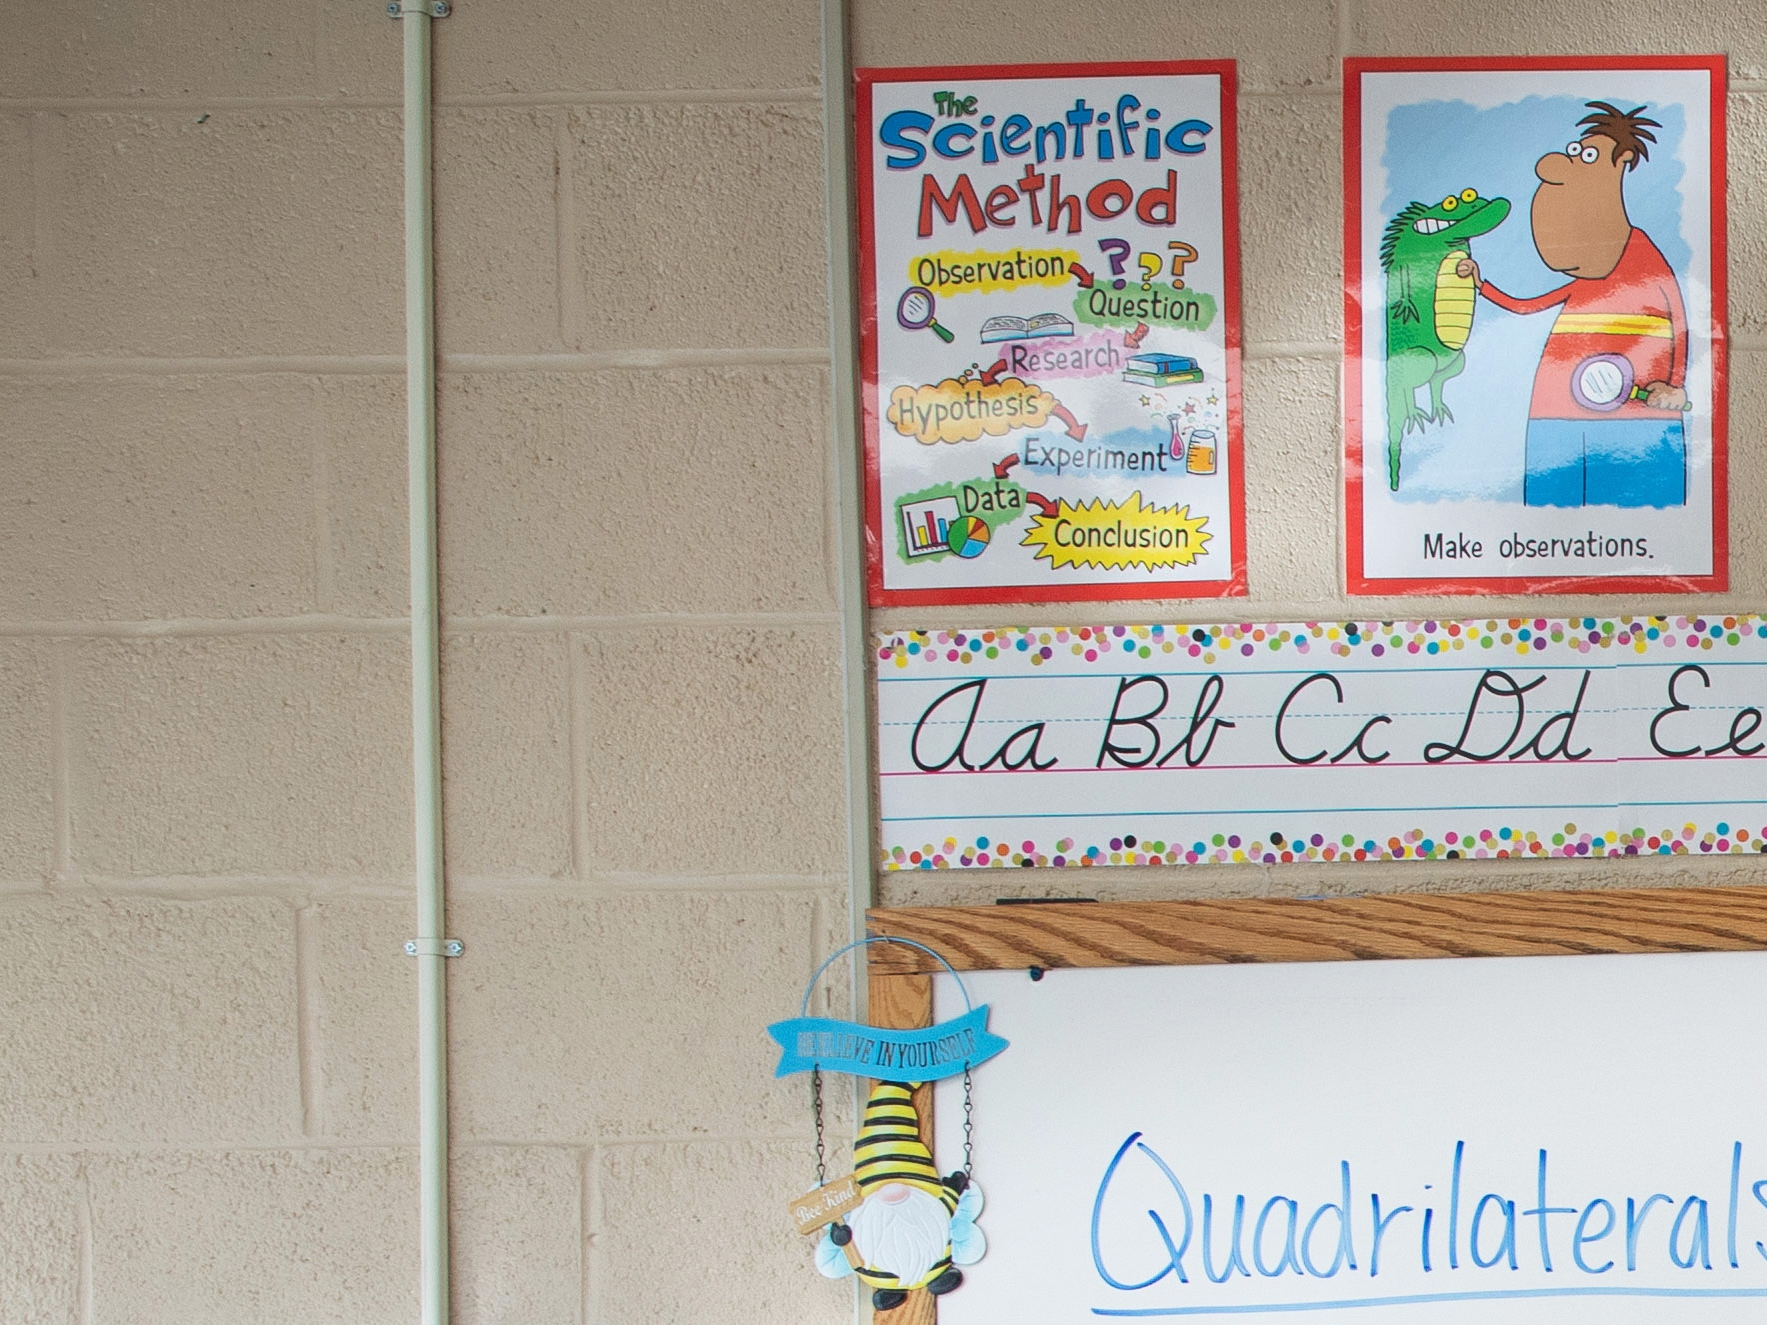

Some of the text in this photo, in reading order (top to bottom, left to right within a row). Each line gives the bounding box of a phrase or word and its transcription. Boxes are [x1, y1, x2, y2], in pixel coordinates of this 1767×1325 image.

[931, 91, 978, 120] The
[880, 94, 1212, 170] Scientific
[917, 162, 1179, 241] Method
[916, 252, 1066, 288] Observation
[1089, 288, 1201, 324] Question
[1011, 340, 1122, 373] Research
[898, 392, 1039, 431] Hypothesis
[1023, 438, 1169, 475] Experiment
[962, 483, 1022, 514] Data
[1054, 517, 1189, 552] Conclusion
[1423, 531, 1654, 559] Make observations.
[910, 679, 1058, 773] Aa
[1094, 674, 1238, 770] Bb
[1422, 668, 1594, 764] Dd
[876, 1041, 895, 1066] IN
[896, 1028, 976, 1068] YOURSELF
[796, 1185, 857, 1226] Bee Kind
